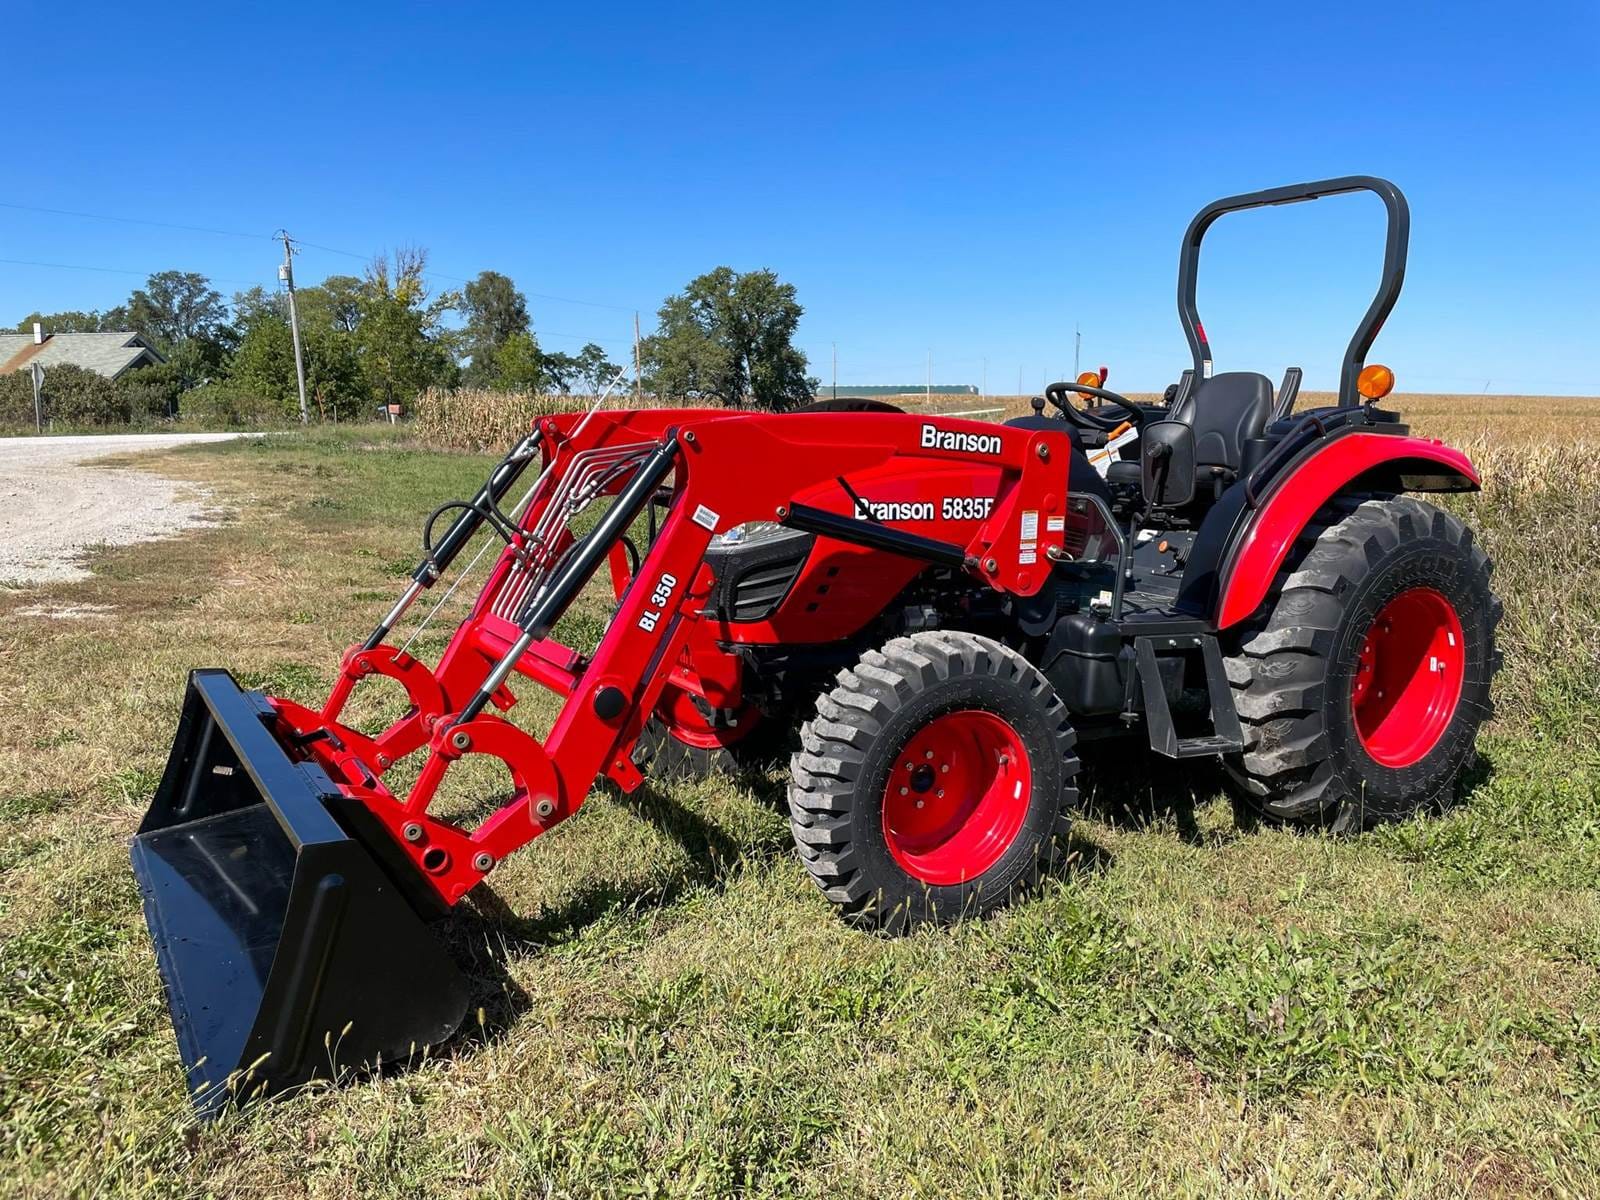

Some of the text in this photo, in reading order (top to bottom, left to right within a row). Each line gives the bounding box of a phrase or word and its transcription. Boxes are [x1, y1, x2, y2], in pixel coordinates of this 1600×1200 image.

[921, 424, 1002, 454] Branson
[638, 573, 677, 632] BL 350
